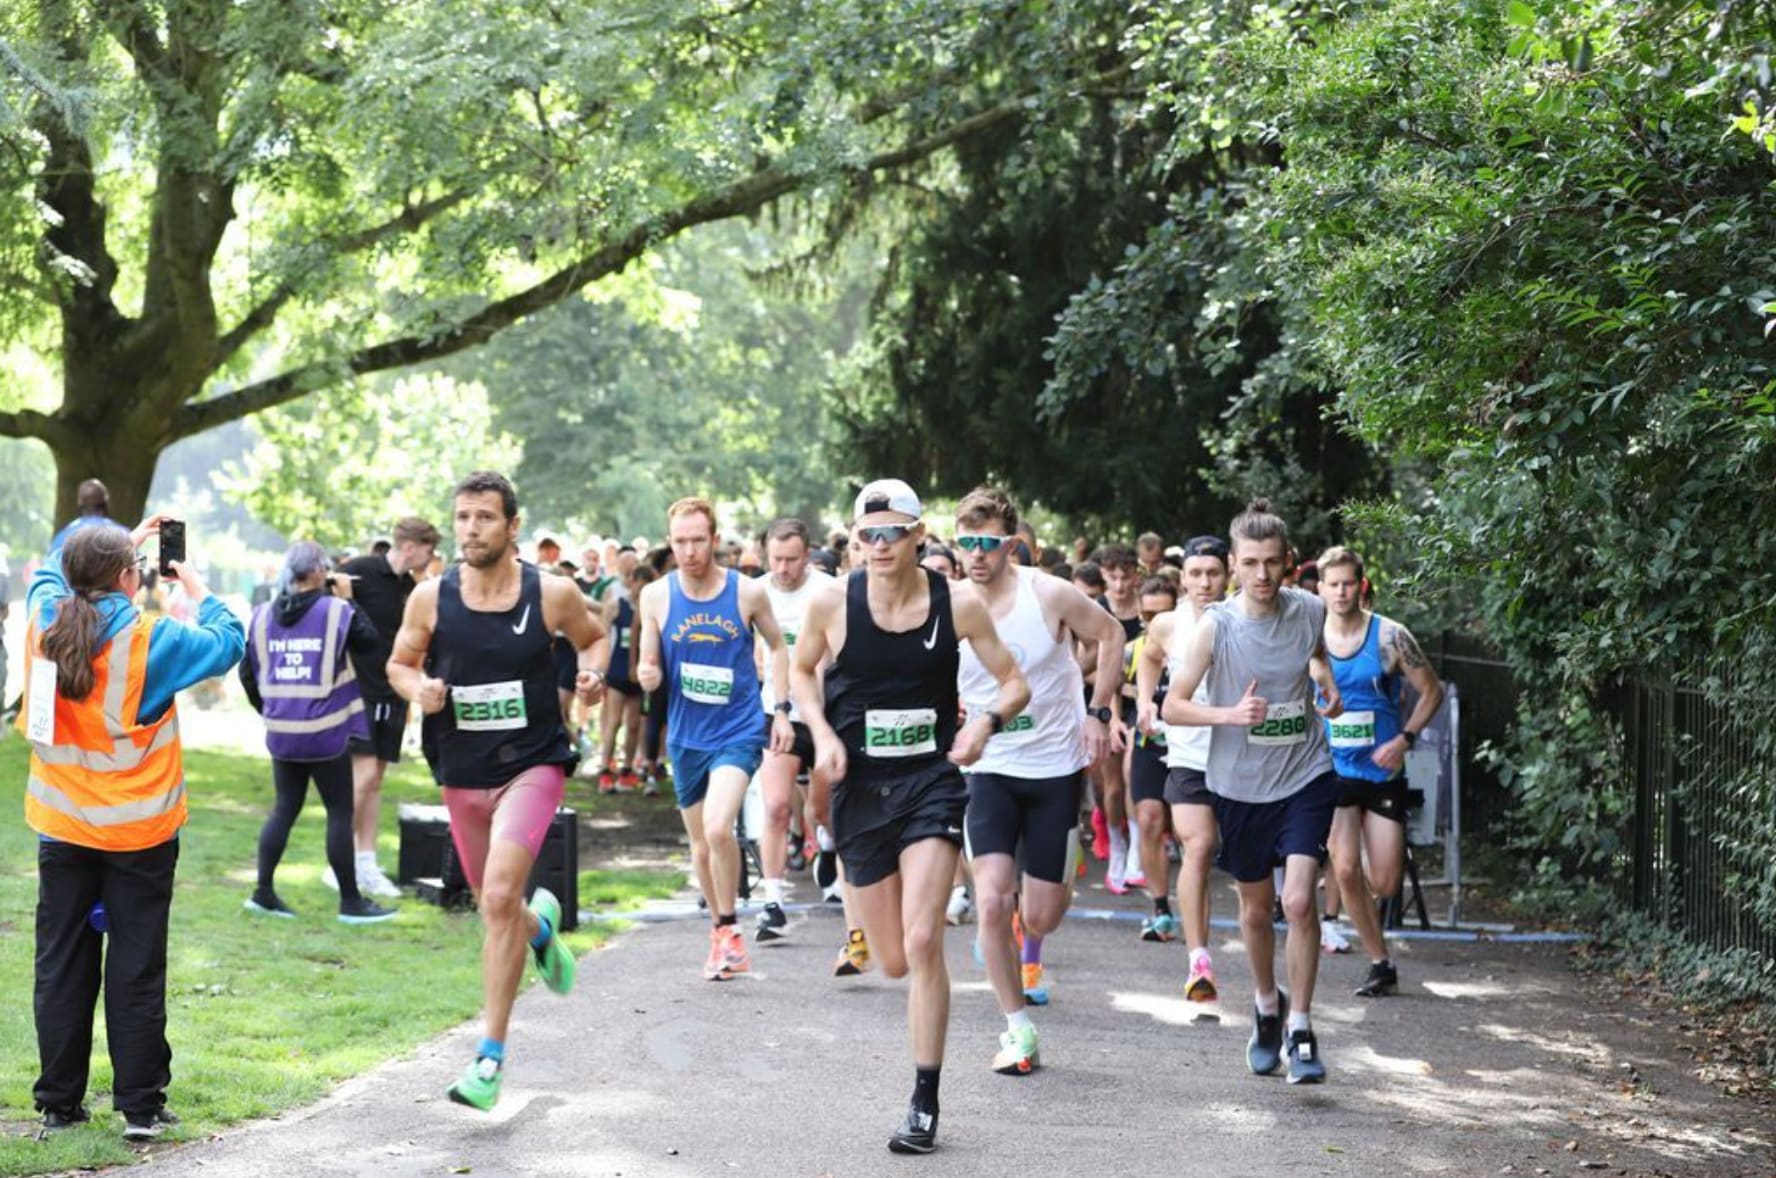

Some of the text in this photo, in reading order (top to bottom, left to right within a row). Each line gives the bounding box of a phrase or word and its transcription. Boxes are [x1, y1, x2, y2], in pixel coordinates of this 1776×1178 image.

[671, 612, 739, 642] RANELAGH
[269, 638, 322, 653] I'M HERE
[285, 653, 303, 666] TO
[275, 667, 312, 680] HELP!
[682, 677, 732, 696] 4822
[461, 699, 521, 721] 2316
[871, 725, 931, 747] 2168
